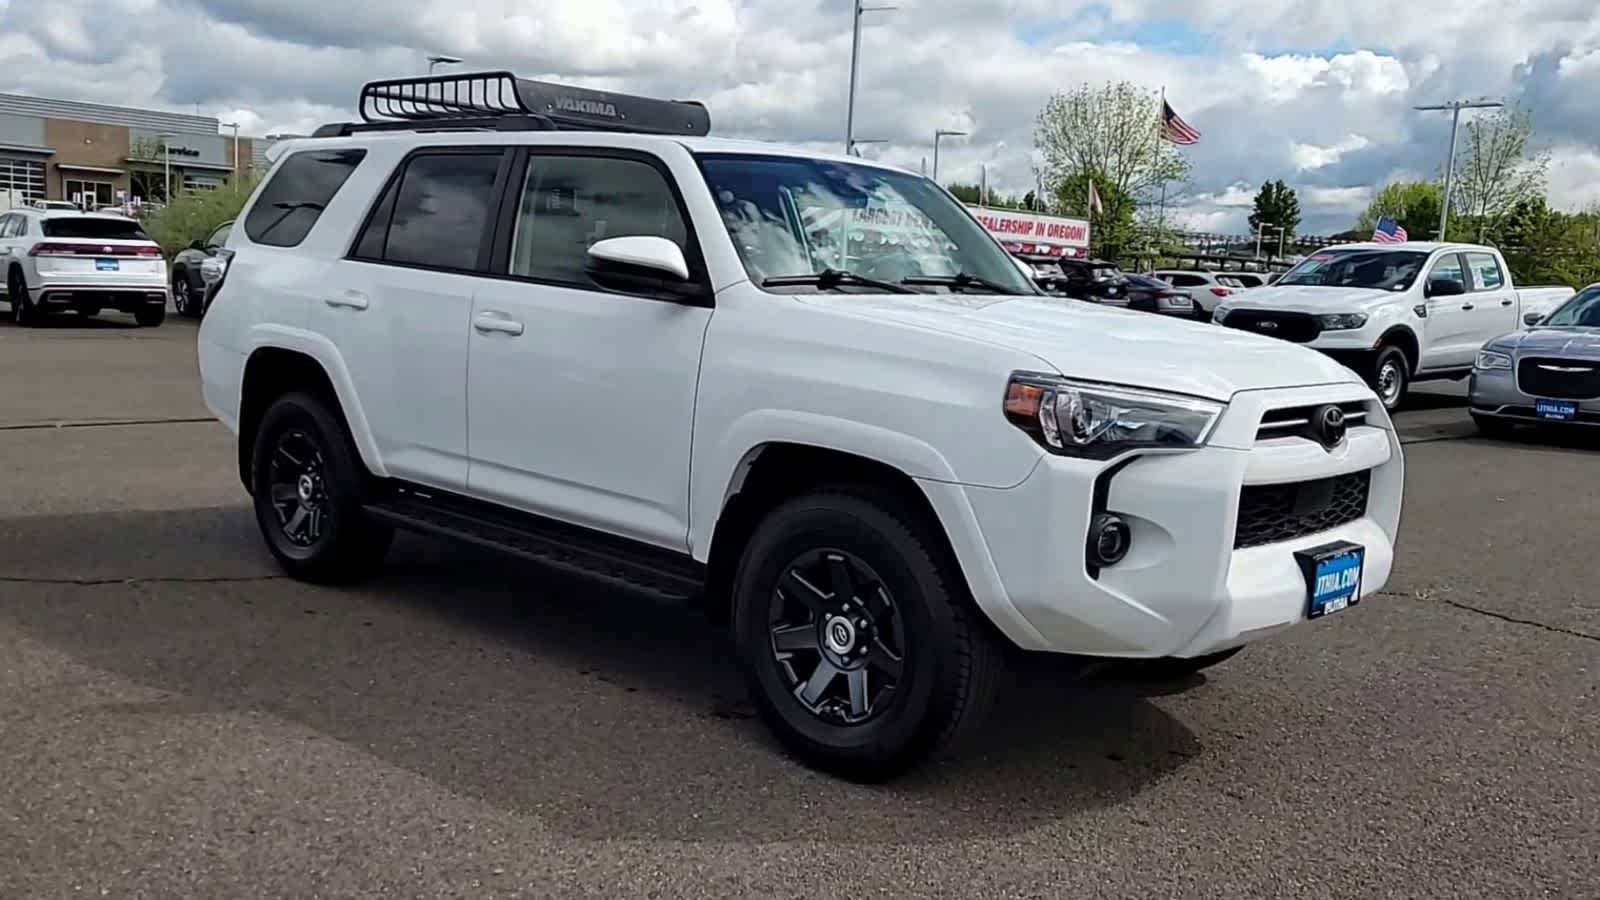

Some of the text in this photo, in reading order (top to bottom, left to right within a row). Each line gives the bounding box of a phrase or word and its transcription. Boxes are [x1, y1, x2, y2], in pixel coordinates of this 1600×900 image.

[554, 97, 616, 117] YAKIMA
[1035, 222, 1045, 235] IN
[1047, 223, 1086, 241] OREGON!
